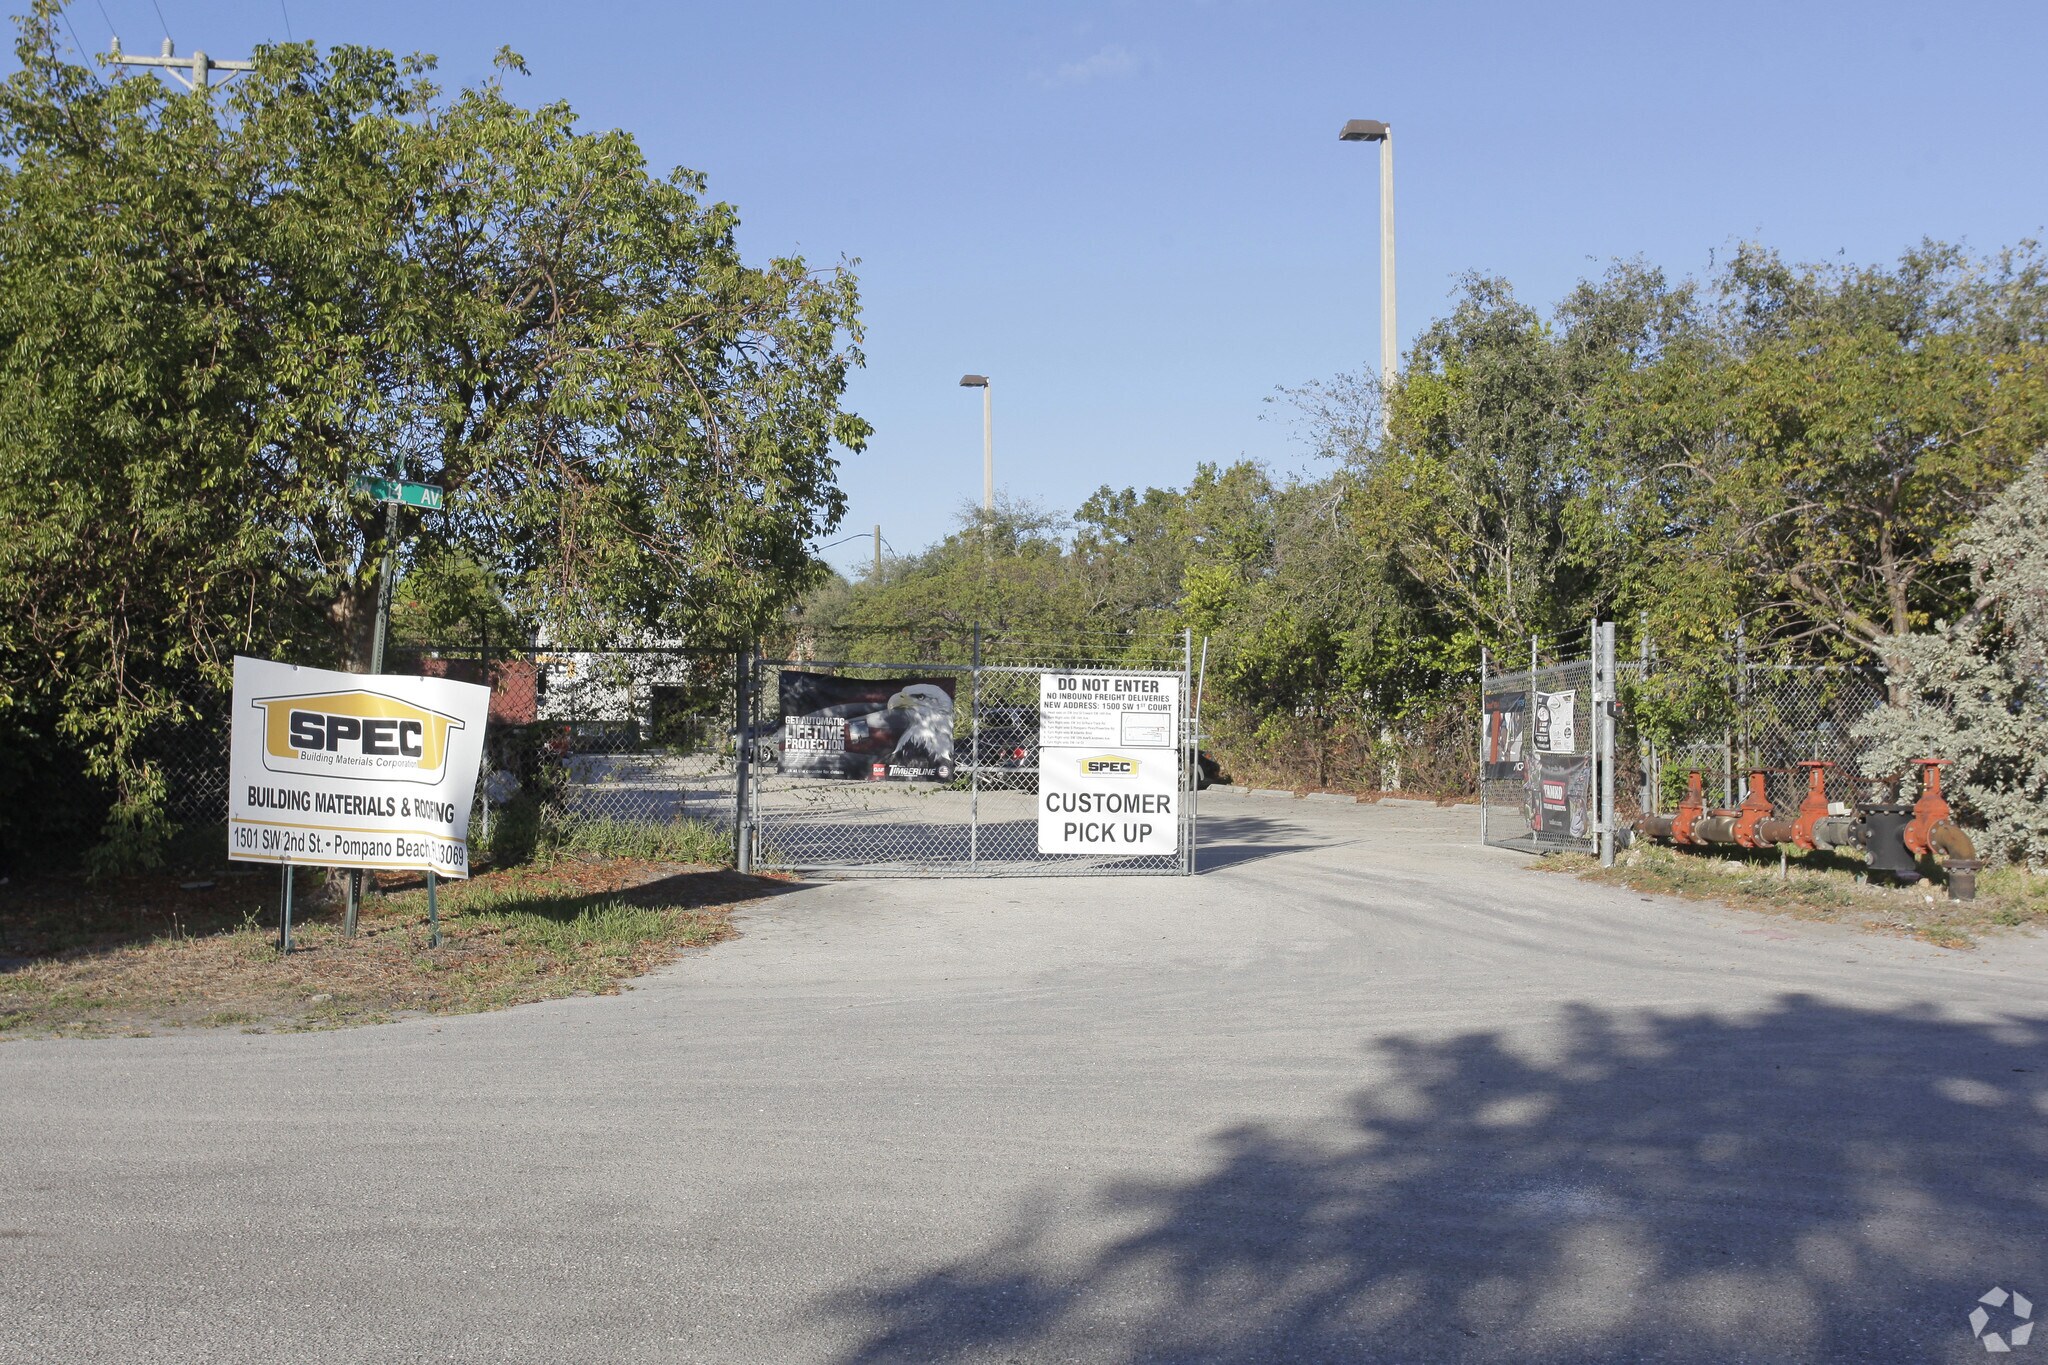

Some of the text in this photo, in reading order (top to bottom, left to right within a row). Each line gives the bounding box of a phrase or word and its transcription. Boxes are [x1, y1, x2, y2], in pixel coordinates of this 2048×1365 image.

[420, 488, 440, 506] AV
[1058, 677, 1159, 693] DO NOT ENTER
[1059, 693, 1093, 701] INBOUND
[1095, 693, 1126, 702] FREIGHT
[1128, 694, 1170, 702] DELIVERIES
[1044, 701, 1061, 709] NEW
[1063, 702, 1100, 710] ADDRESS:
[1102, 702, 1120, 710] 1500
[1148, 703, 1172, 711] COURT
[785, 715, 845, 726] GET AUTOMATIC
[290, 711, 422, 758] SPEC
[785, 725, 845, 740] LIFETIME
[785, 739, 845, 750] PROTECTION
[301, 751, 418, 769] Building Materials Corporation
[1088, 761, 1131, 772] SPEC
[888, 764, 936, 777] TIMBERLINE
[248, 786, 455, 824] BUILDING MATERIALS & ROOFING
[1046, 792, 1171, 814] CUSTOMER
[1064, 822, 1153, 843] PICK UP
[234, 827, 259, 849] 1501
[262, 829, 281, 850] SW
[284, 831, 305, 852] 2nd
[308, 832, 324, 853] St.
[334, 834, 391, 860] Pompano
[396, 837, 431, 858] Beach
